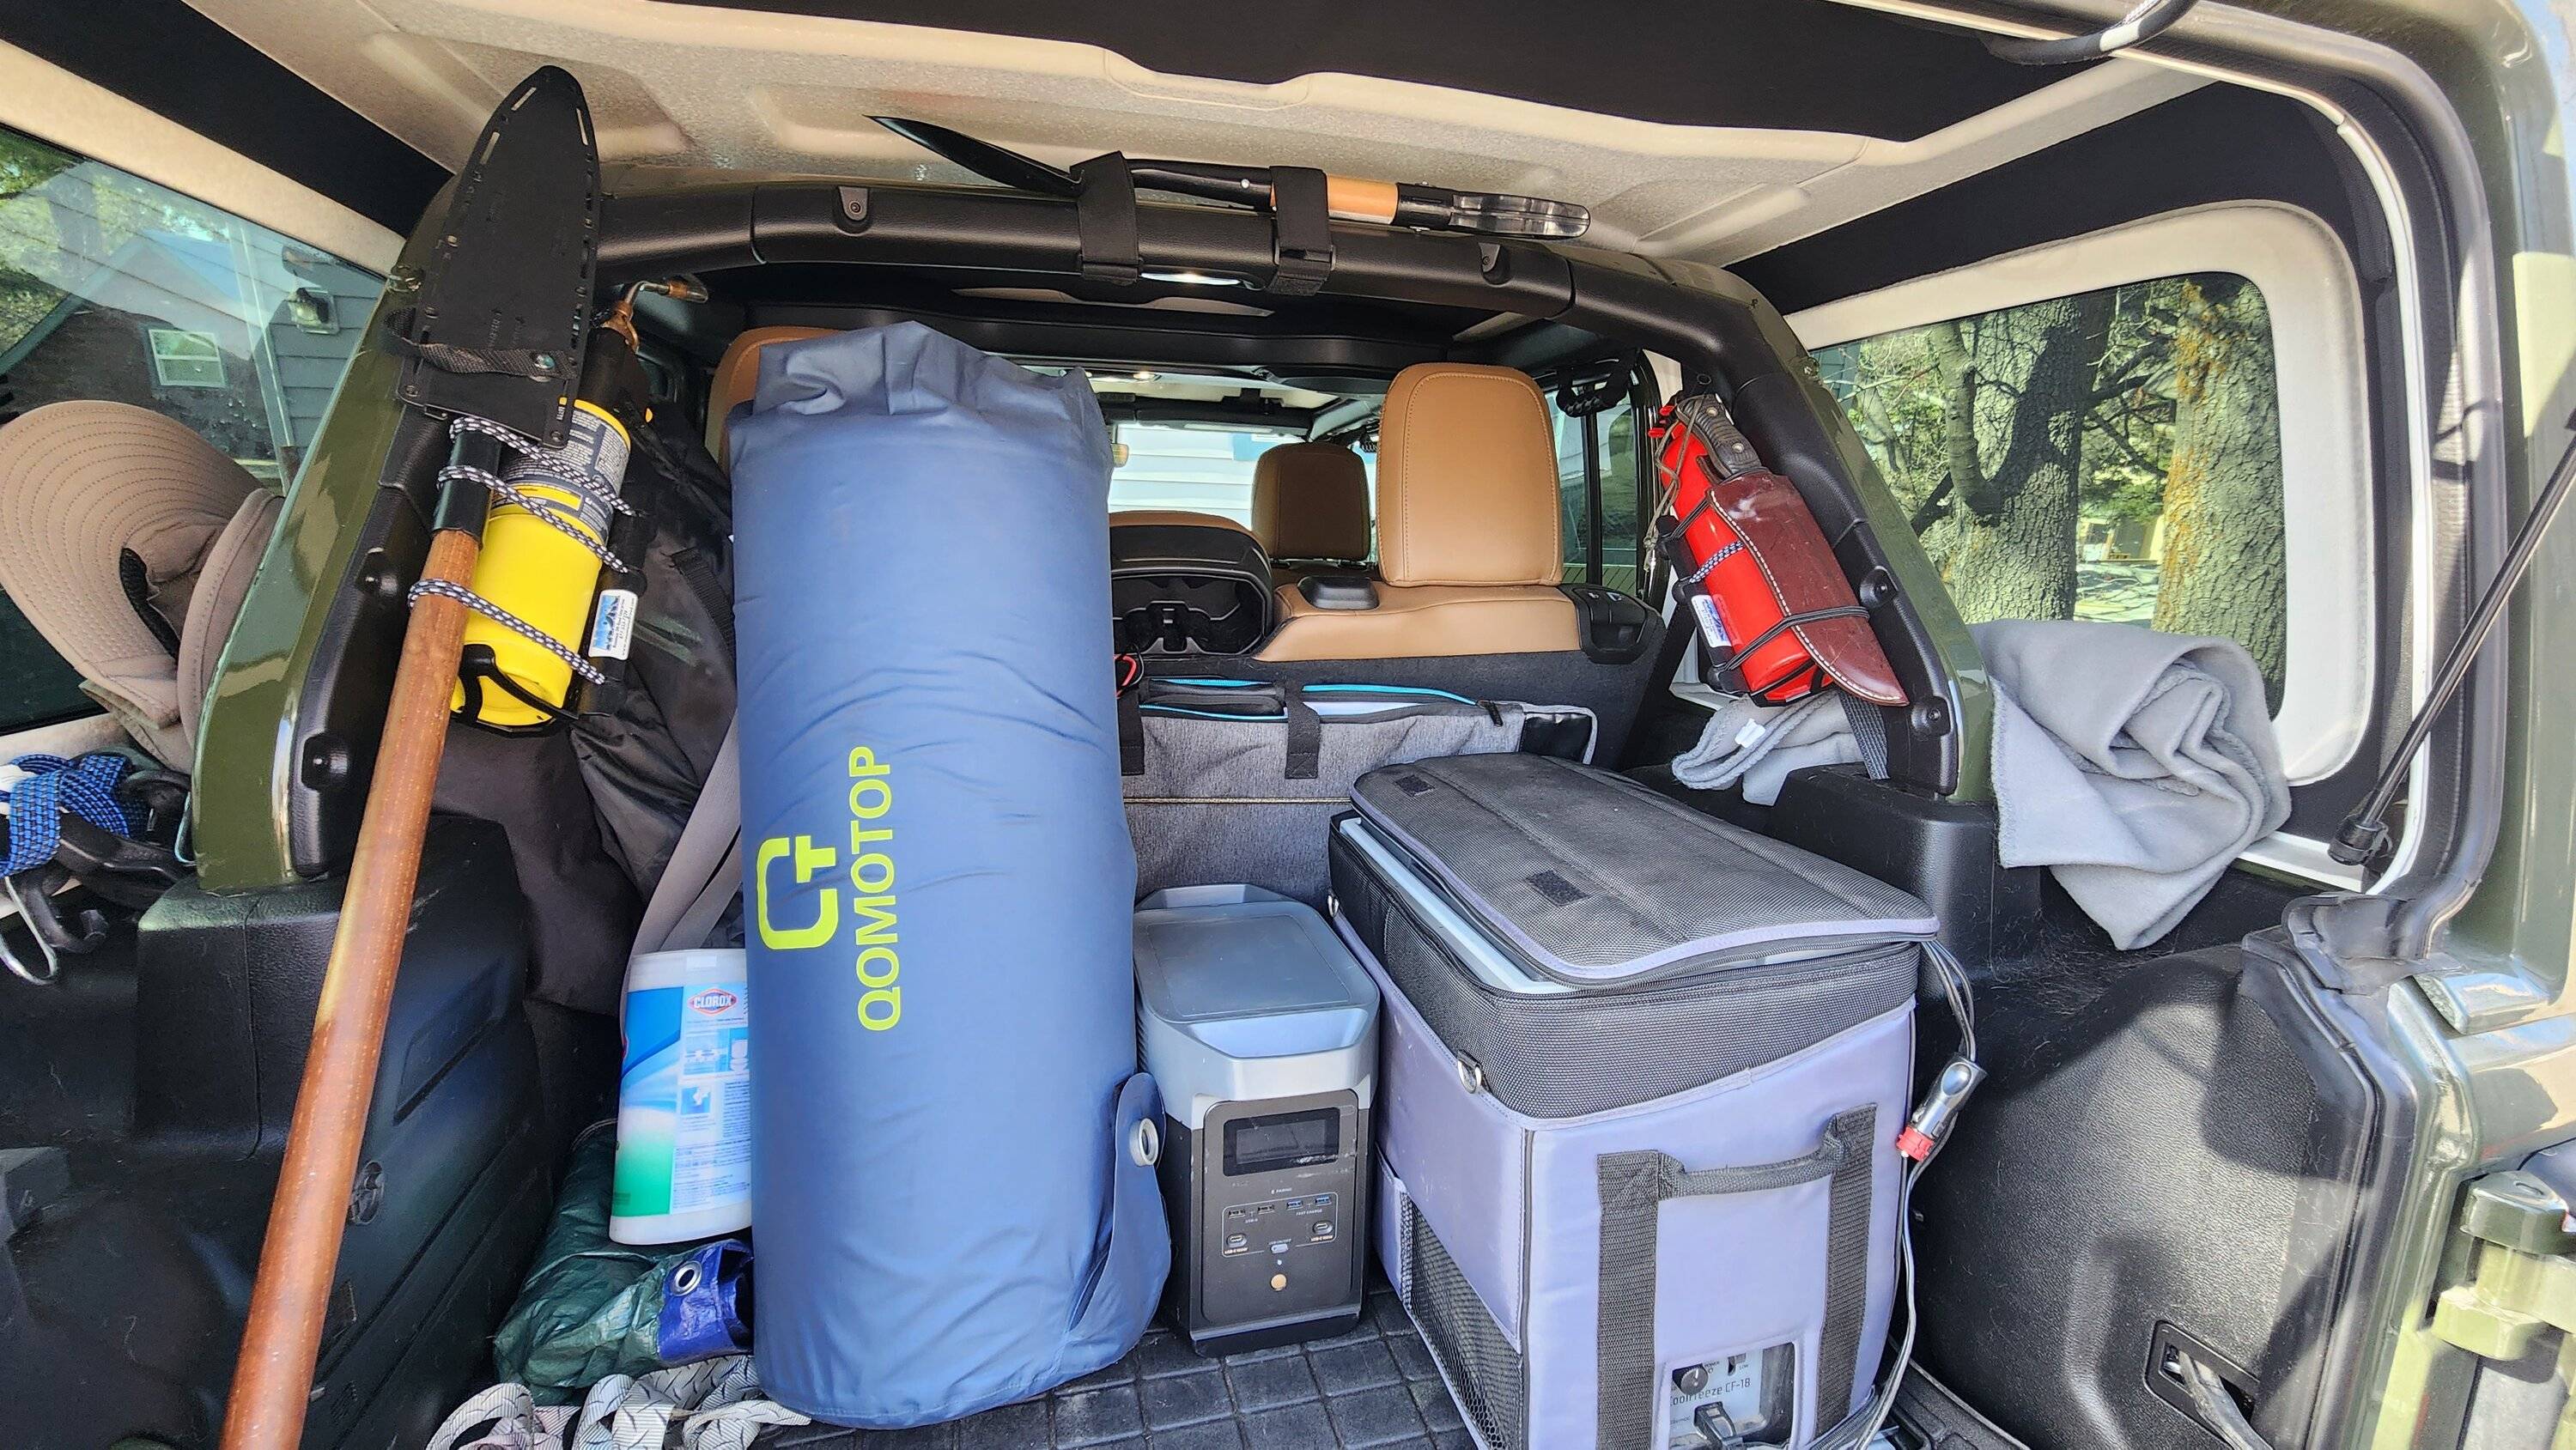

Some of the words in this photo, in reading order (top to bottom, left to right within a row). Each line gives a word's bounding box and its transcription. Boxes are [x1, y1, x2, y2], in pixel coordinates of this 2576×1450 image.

[848, 746, 901, 1030] QOMOTOP
[694, 994, 732, 1009] CLOROX
[1725, 1378, 1751, 1392] CF-18
